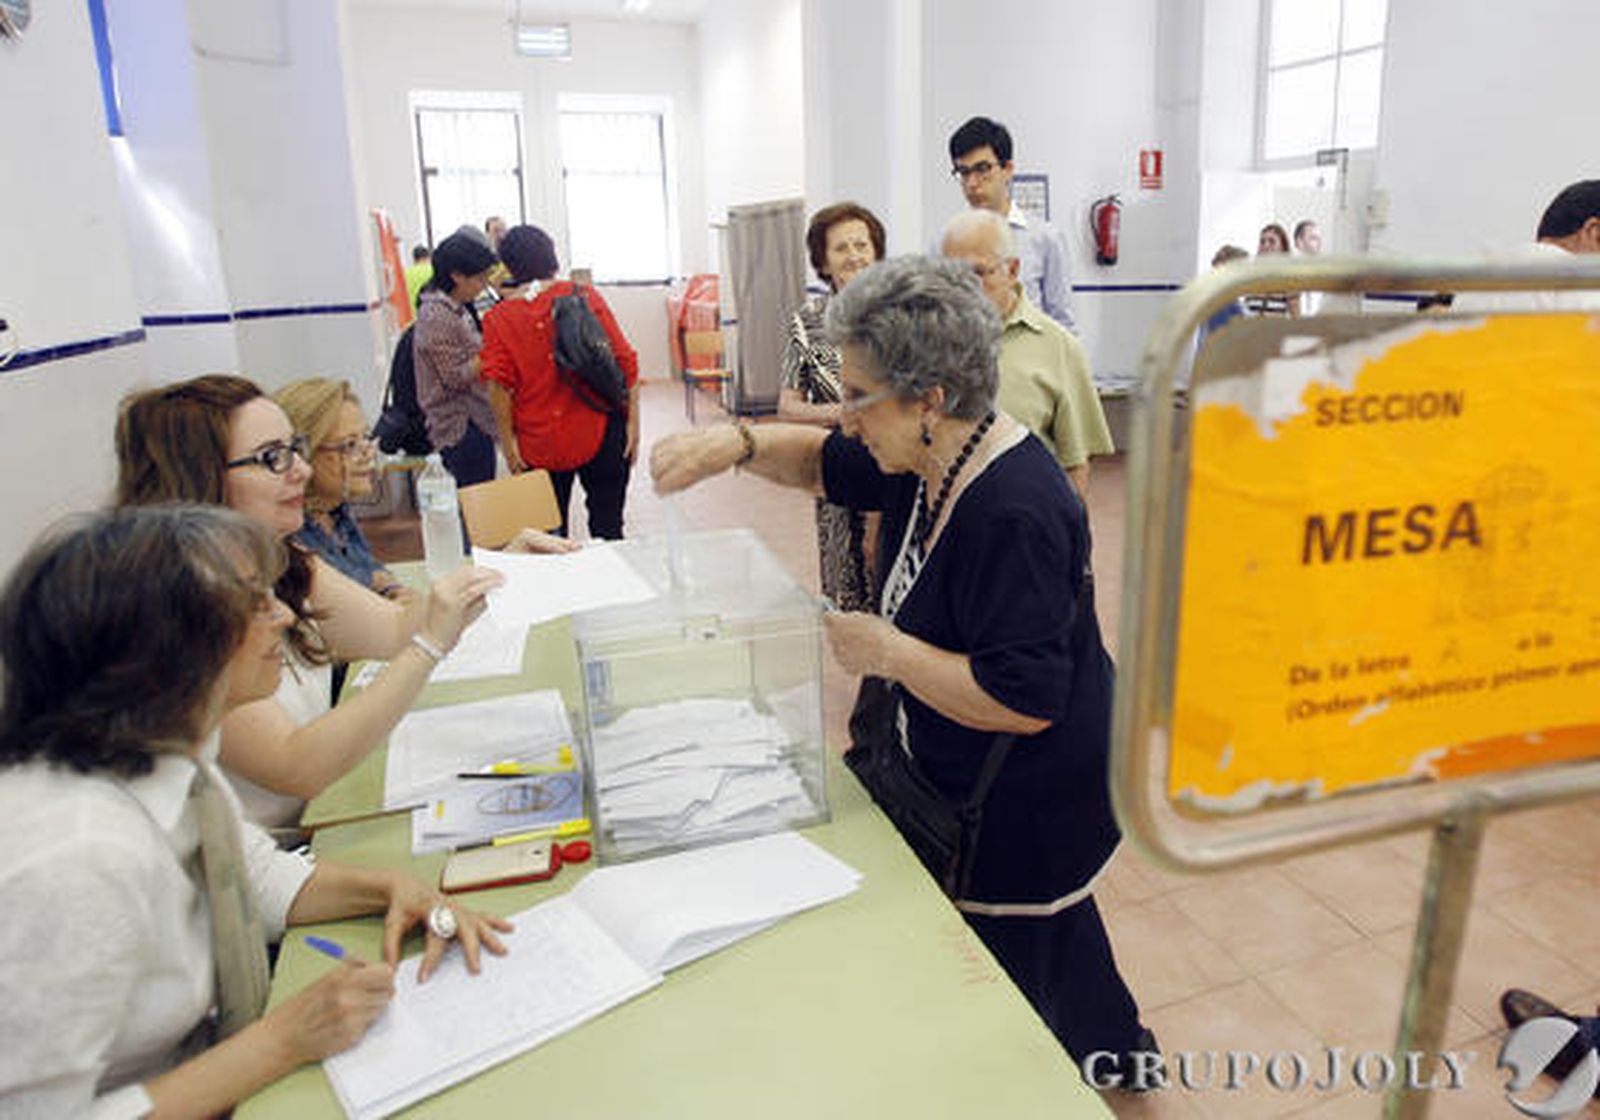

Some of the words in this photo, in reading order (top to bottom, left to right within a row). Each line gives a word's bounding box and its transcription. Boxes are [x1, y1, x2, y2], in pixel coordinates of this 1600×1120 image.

[1315, 389, 1465, 427] SECCION
[1302, 501, 1483, 566] MESA
[1290, 664, 1320, 686] De
[1330, 660, 1349, 680] la
[1358, 653, 1410, 675] letra
